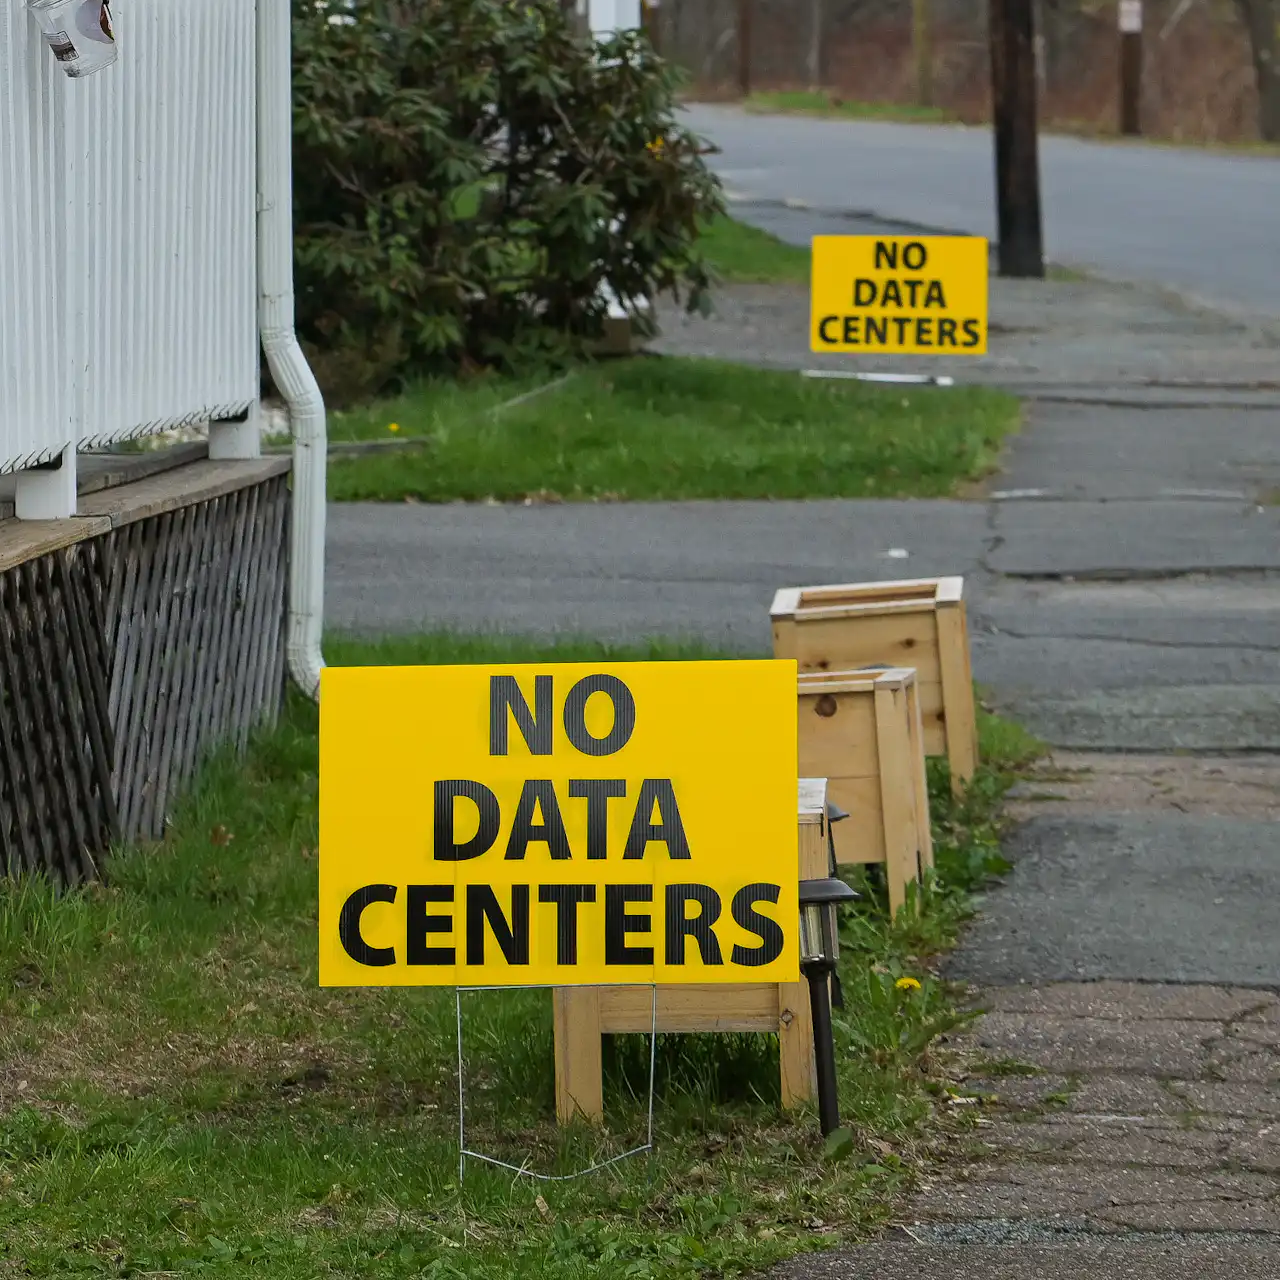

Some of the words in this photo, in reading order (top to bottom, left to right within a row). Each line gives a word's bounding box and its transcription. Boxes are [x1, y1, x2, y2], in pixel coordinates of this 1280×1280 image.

[875, 241, 927, 271] NO
[853, 278, 947, 309] DATA
[818, 315, 980, 347] CENTERS
[489, 673, 636, 757] NO
[433, 778, 692, 862] DATA
[338, 882, 785, 967] CENTERS
